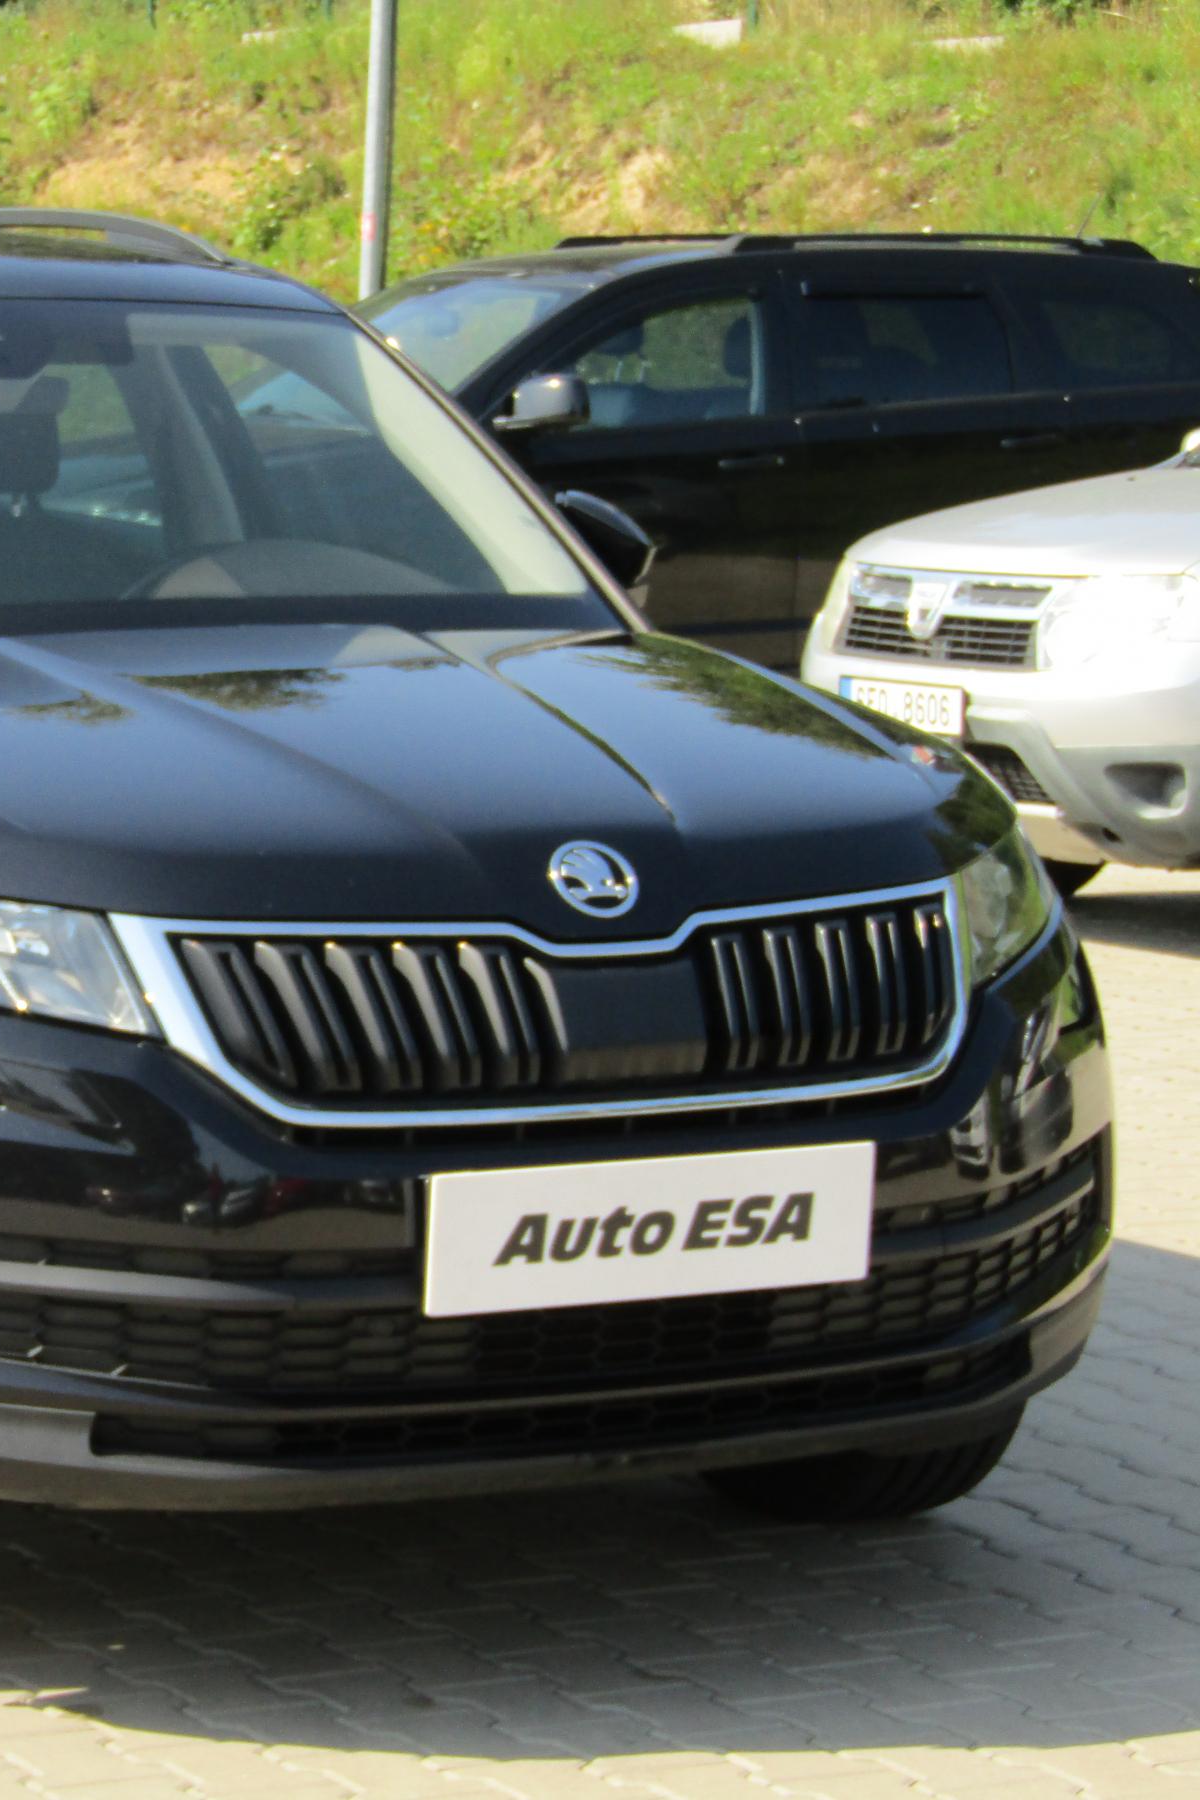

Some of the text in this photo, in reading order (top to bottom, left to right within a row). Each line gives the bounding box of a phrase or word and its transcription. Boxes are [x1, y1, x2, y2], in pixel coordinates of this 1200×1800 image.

[903, 691, 950, 726] 8606
[493, 1192, 814, 1267] Auto ESA
